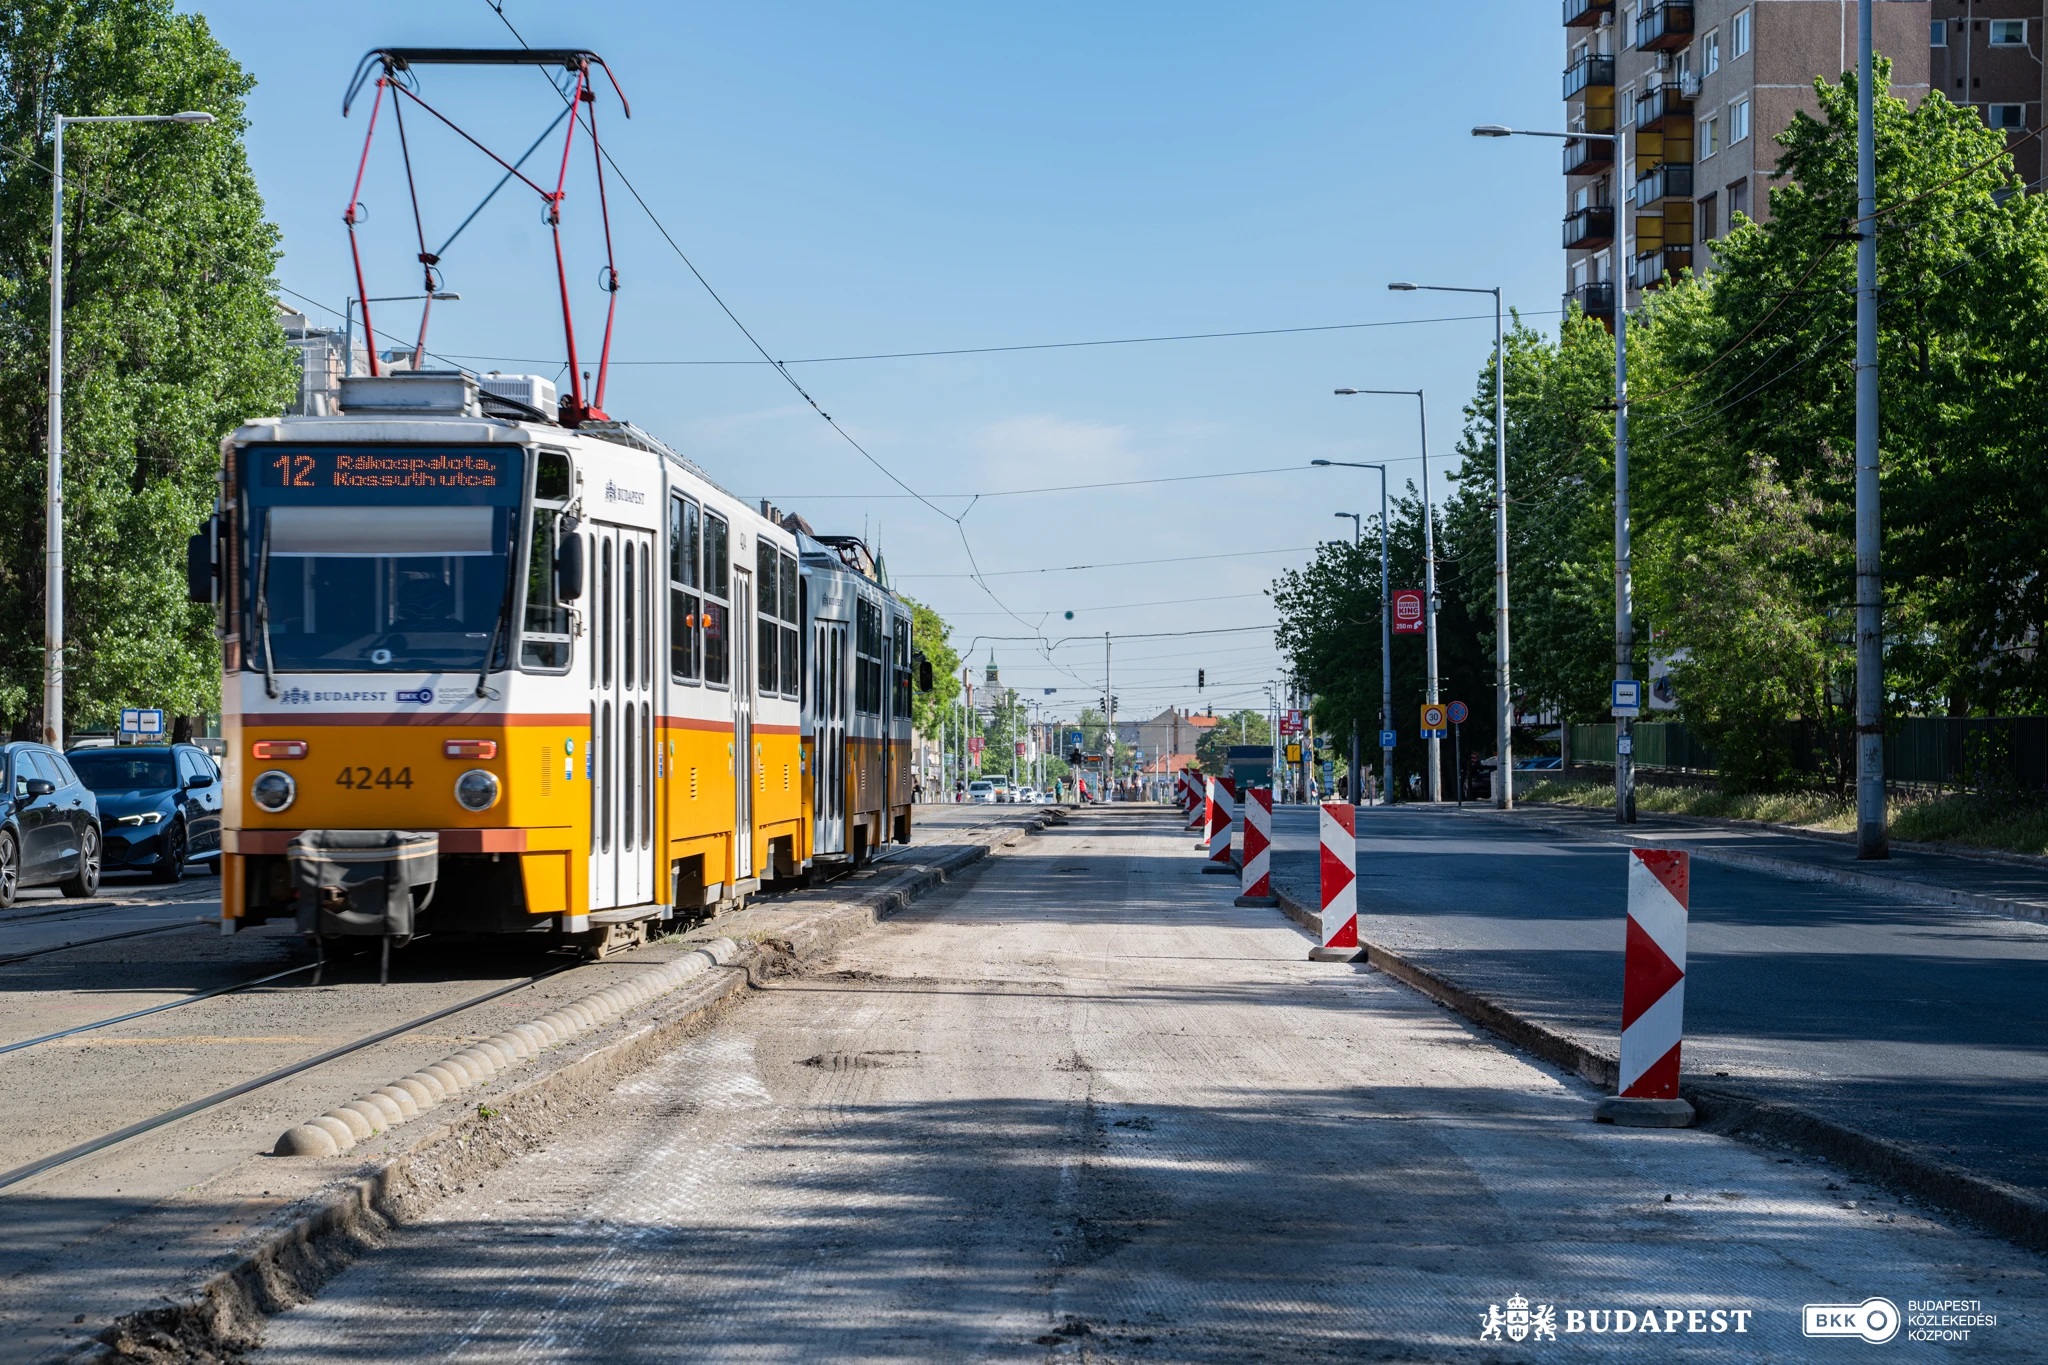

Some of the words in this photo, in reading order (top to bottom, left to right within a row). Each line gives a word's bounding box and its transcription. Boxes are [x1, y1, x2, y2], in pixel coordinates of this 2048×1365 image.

[273, 455, 316, 486] 12
[333, 472, 436, 486] Kossuth
[439, 472, 496, 486] utca
[314, 691, 388, 702] BUDAPEST
[1428, 713, 1439, 721] 30
[1382, 732, 1393, 745] P
[336, 766, 415, 790] 4244
